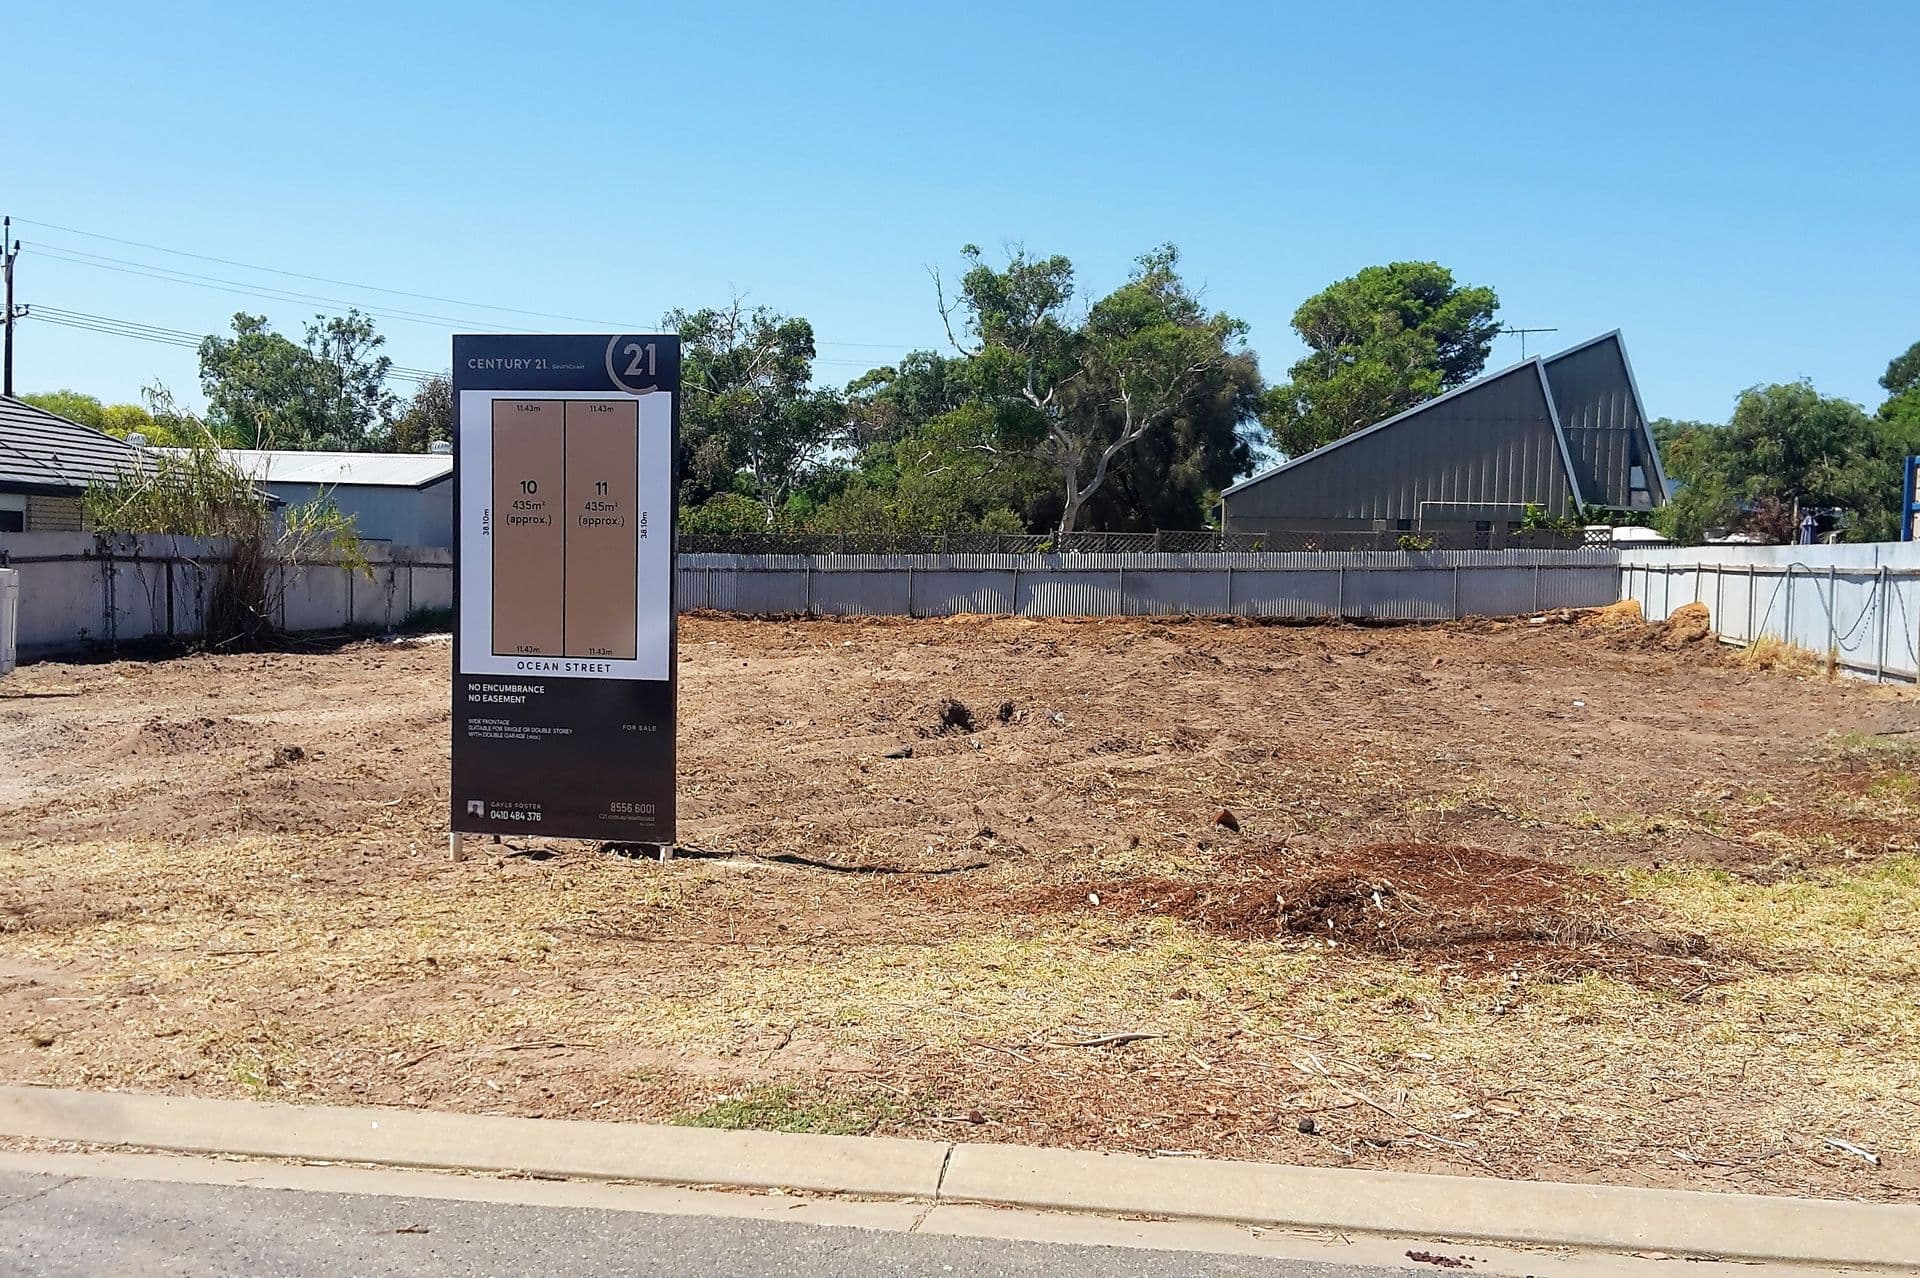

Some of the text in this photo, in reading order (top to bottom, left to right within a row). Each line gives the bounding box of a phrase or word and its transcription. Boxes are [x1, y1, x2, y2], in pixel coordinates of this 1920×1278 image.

[467, 358, 547, 370] CENTURY 21
[516, 404, 541, 412] 11.43m
[589, 405, 614, 413] 11.43m
[520, 480, 538, 495] 10
[595, 481, 608, 495] 11
[482, 508, 490, 536] 38.10m
[506, 514, 552, 527] (approx.)
[578, 515, 625, 528] (approx.)
[640, 511, 648, 539] 38.10m
[516, 645, 541, 654] 11.43m
[588, 647, 613, 656] 11.43m
[517, 661, 611, 673] OCEAN STREET
[468, 683, 545, 694] NO ENCUMBRANCE
[468, 694, 526, 704] NO EASEMENT
[514, 802, 542, 810] FOSTER
[610, 802, 656, 814] 8556 6001
[490, 810, 509, 819] 0410
[510, 811, 525, 820] 484
